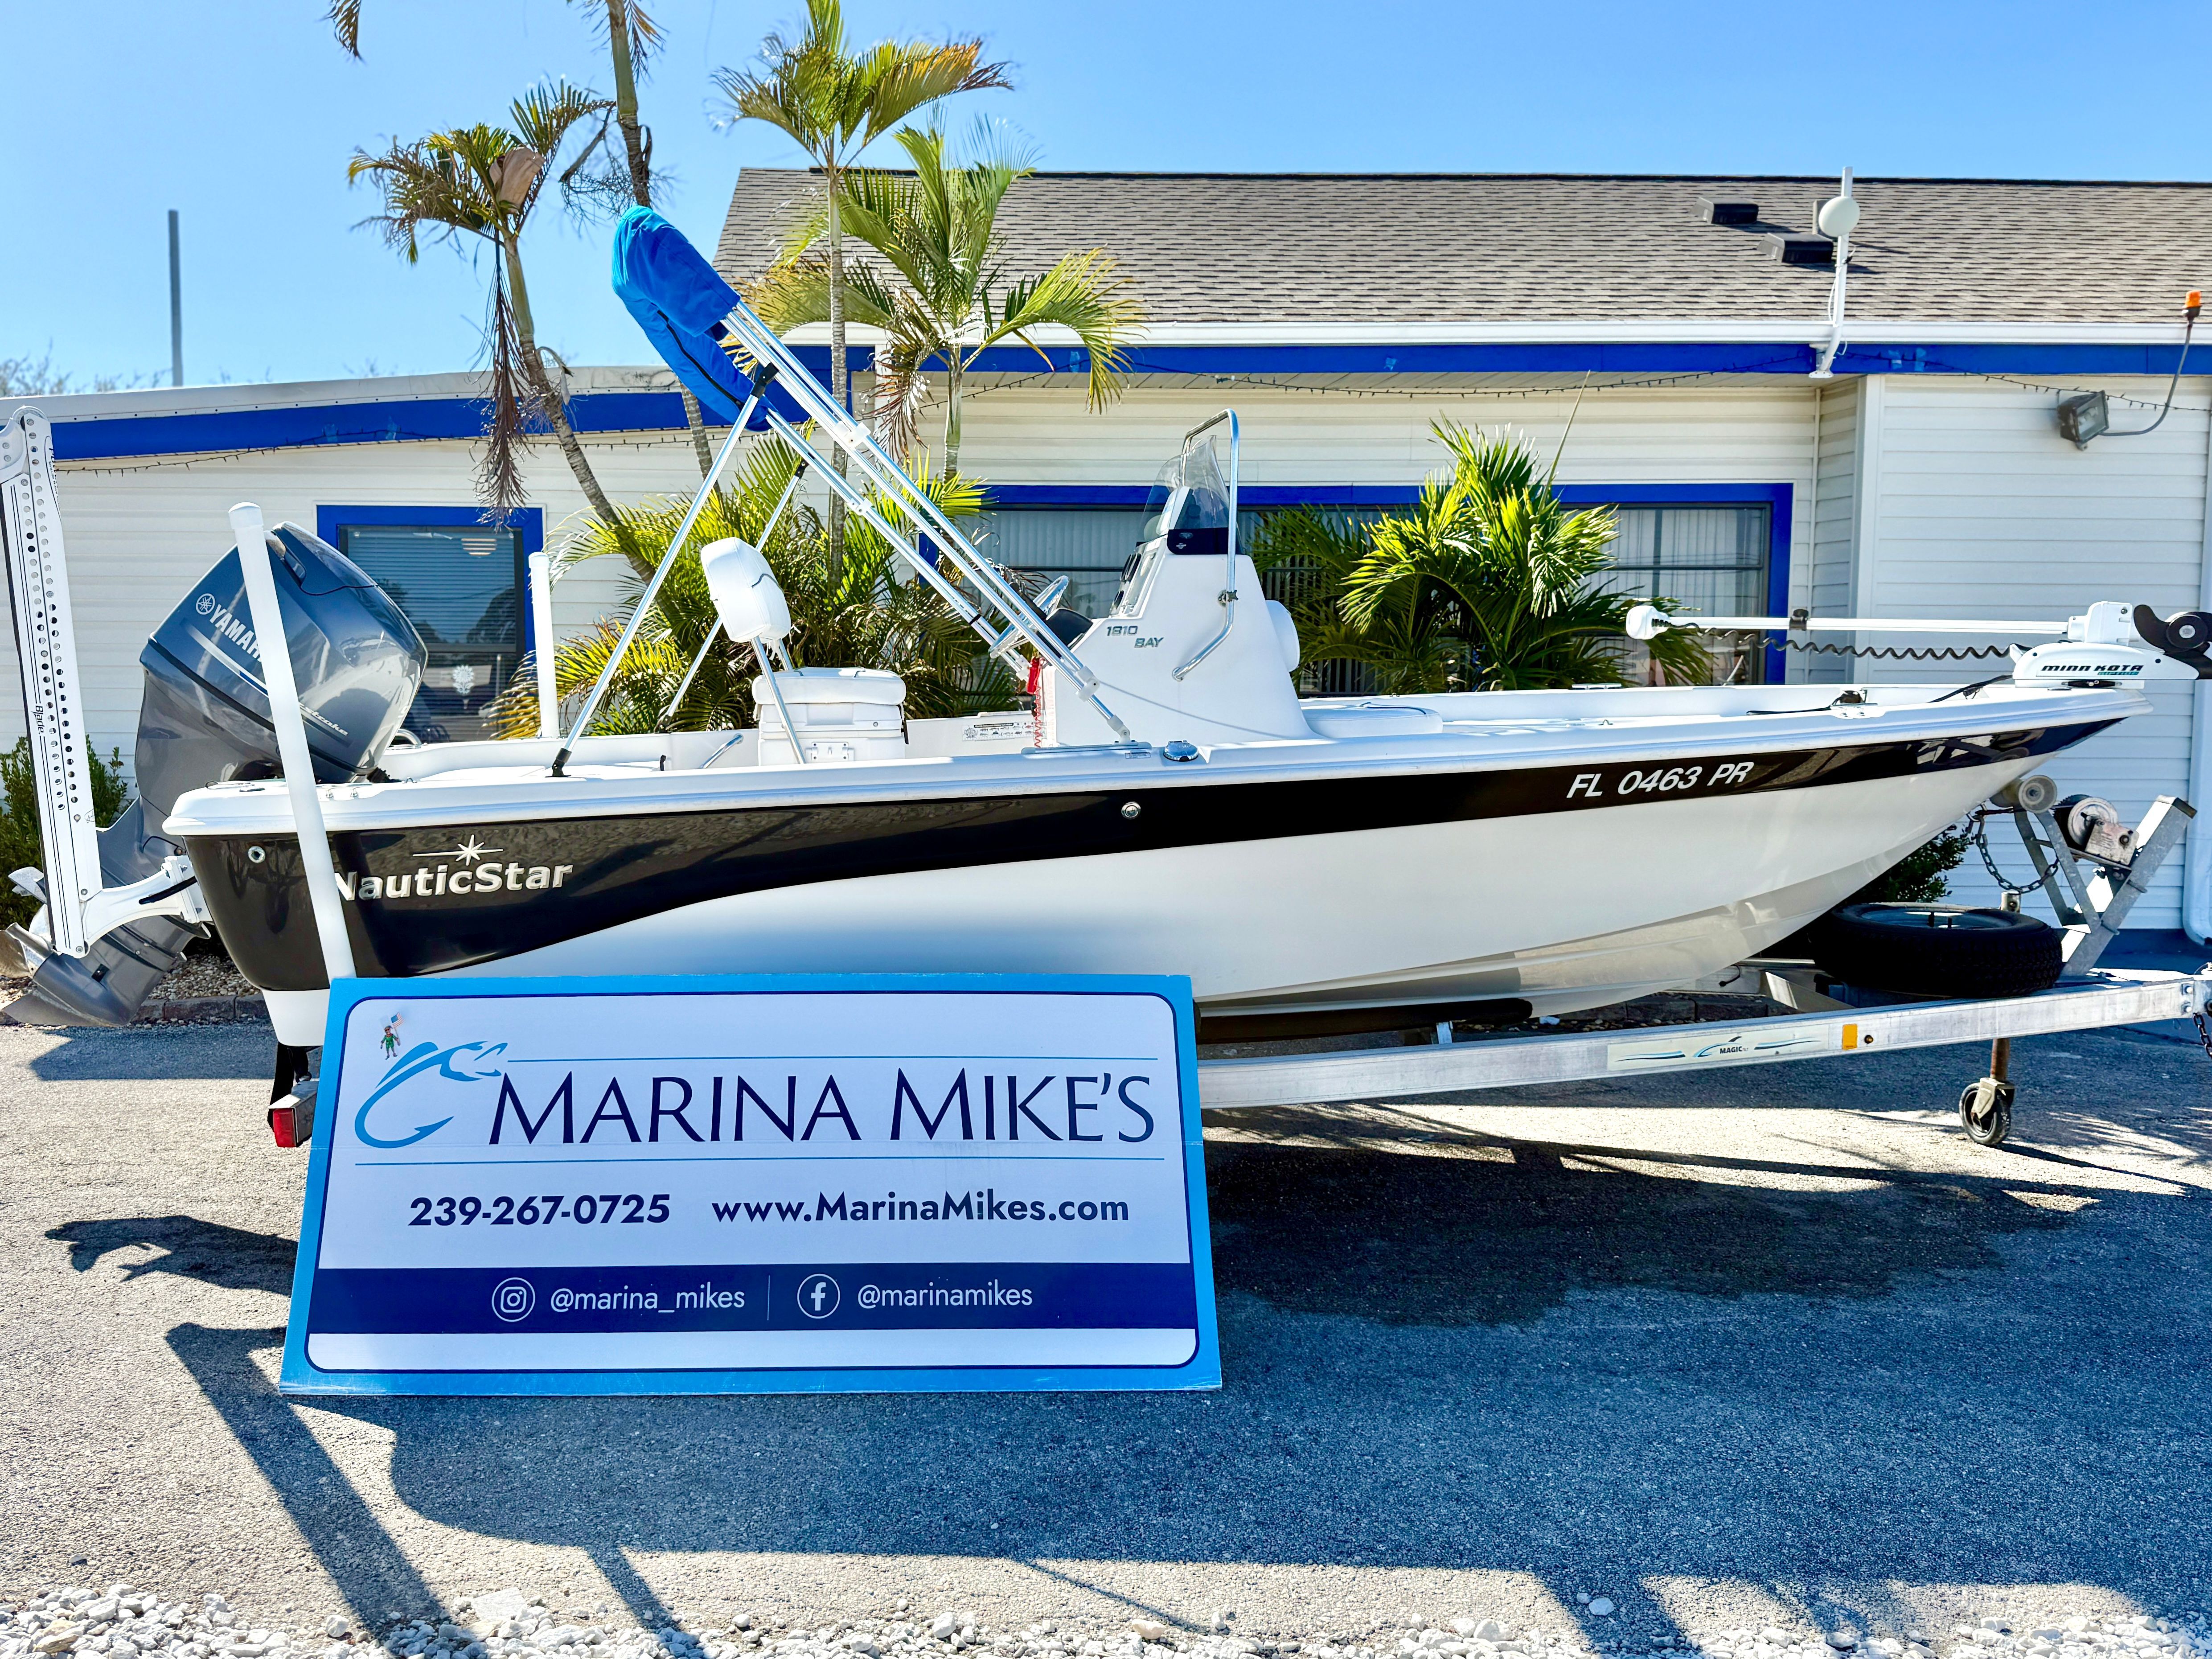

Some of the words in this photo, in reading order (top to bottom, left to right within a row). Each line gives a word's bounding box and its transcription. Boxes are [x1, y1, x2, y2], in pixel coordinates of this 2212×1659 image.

[209, 604, 262, 662] YAMAH
[1107, 626, 1138, 636] 1810
[1134, 637, 1164, 648] BAY
[31, 705, 45, 734] Blade
[1566, 773, 1603, 798] FL
[1617, 766, 1703, 795] 0463
[1707, 761, 1755, 786] PR
[1720, 1046, 1742, 1054] MAGIC
[488, 1071, 862, 1145] MARINA
[890, 1067, 1154, 1143] MIKE'S
[408, 1193, 670, 1226] 239-267-0725
[711, 1188, 1129, 1222] www.MarinaMikes.com
[550, 1281, 745, 1313] @marina_mikes
[857, 1277, 1033, 1310] @marinamikes
